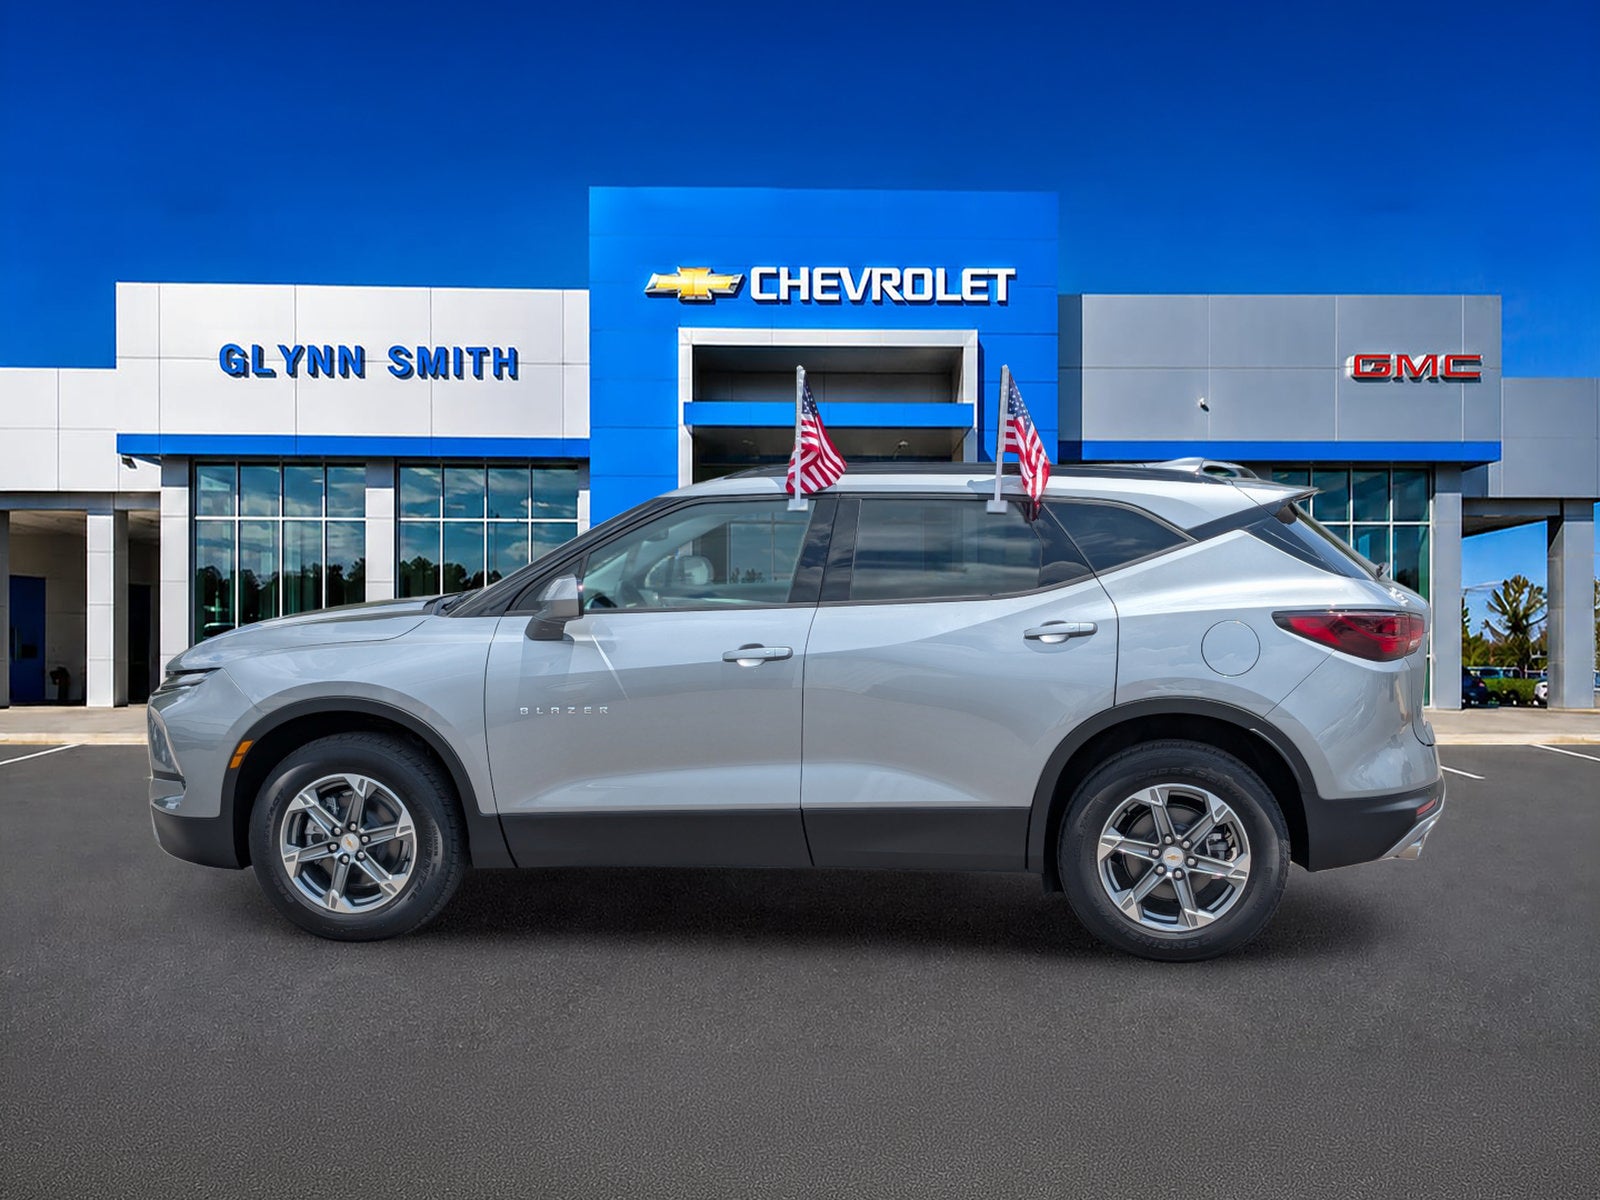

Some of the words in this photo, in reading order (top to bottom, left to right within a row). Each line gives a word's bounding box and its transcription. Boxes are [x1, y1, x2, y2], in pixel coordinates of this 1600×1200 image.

[749, 266, 1016, 304] CHEVROLET
[219, 343, 366, 379] GLYNN
[387, 345, 518, 380] SMITH
[1351, 353, 1482, 380] GMC
[519, 706, 609, 715] BLAZER
